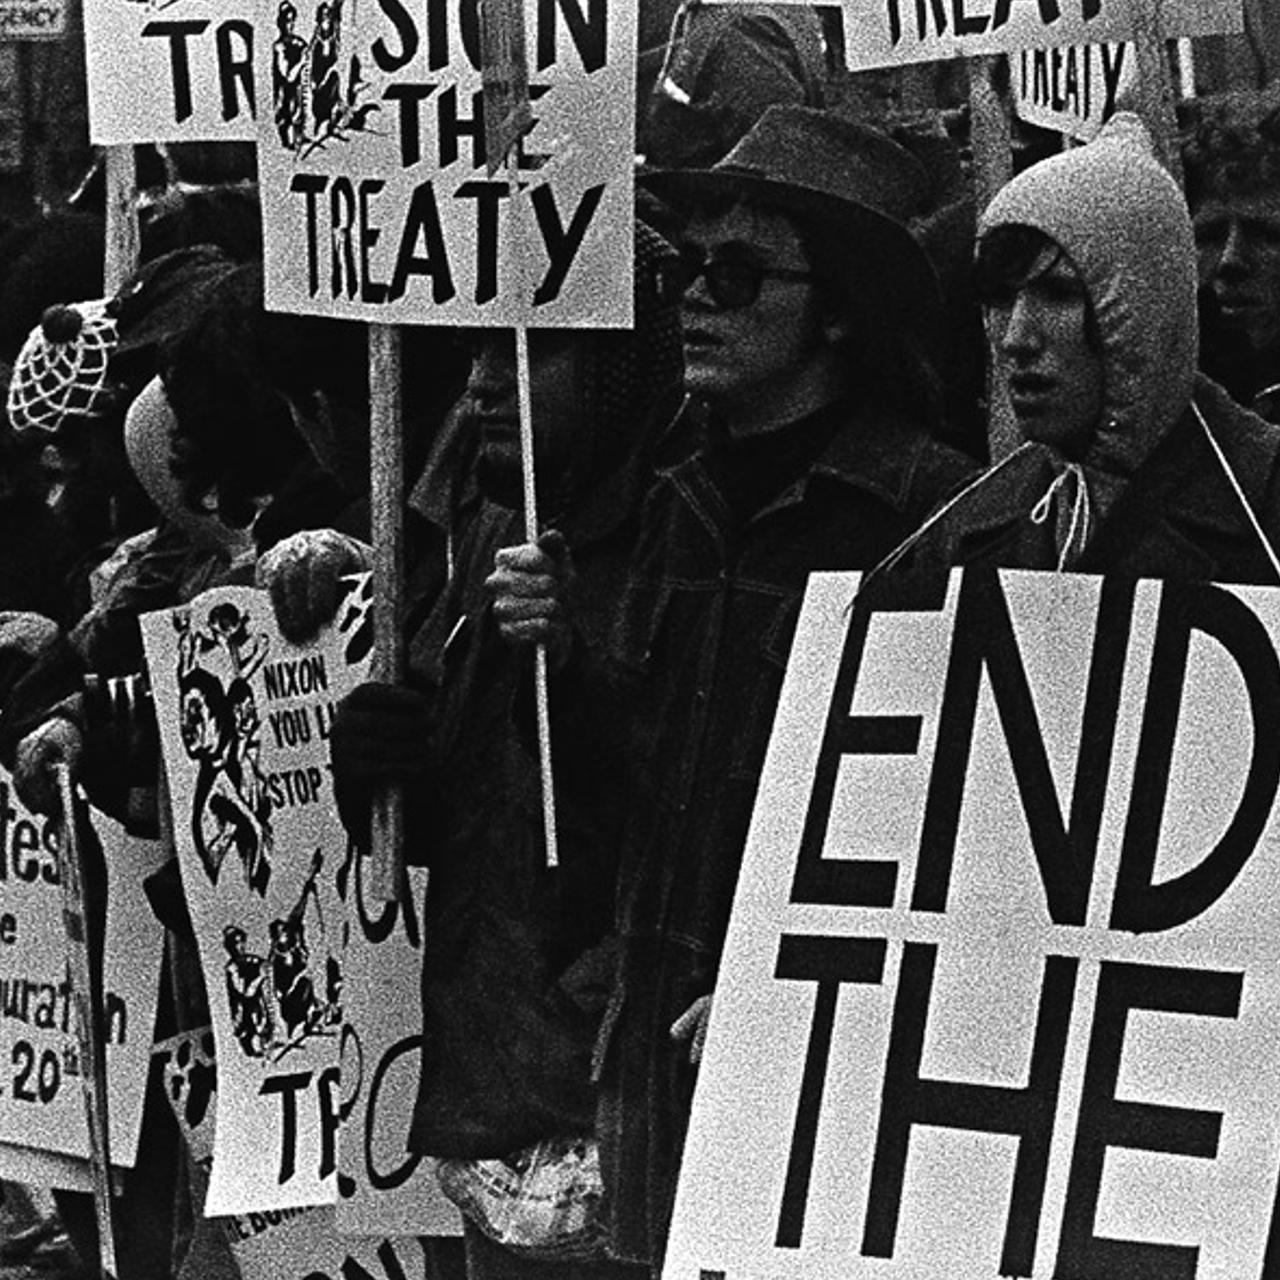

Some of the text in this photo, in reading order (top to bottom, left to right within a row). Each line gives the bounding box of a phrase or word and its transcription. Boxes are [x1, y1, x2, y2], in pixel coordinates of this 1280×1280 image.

[290, 173, 605, 307] TREATY
[264, 655, 327, 700] NIXON
[269, 707, 310, 749] YOU
[269, 767, 322, 809] STOP
